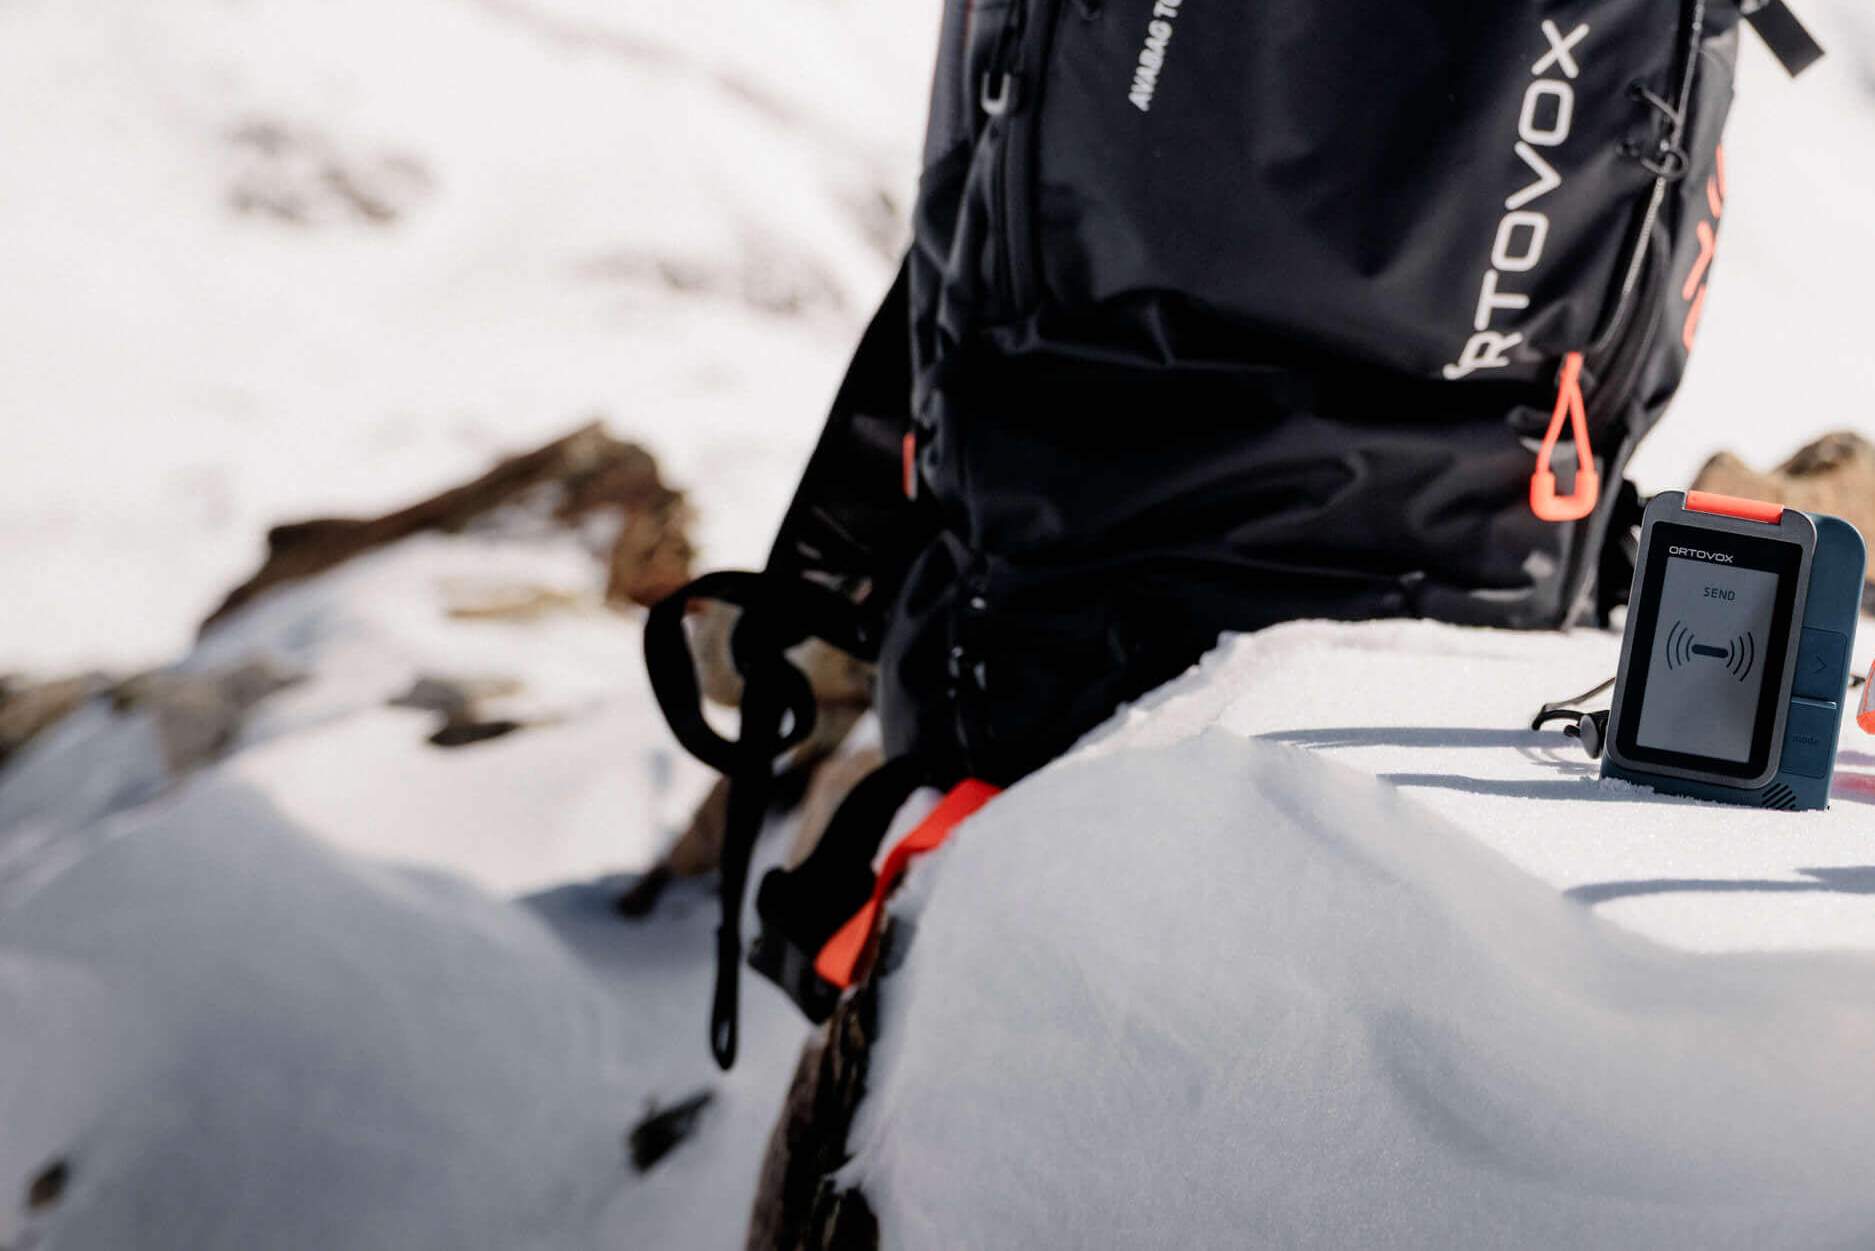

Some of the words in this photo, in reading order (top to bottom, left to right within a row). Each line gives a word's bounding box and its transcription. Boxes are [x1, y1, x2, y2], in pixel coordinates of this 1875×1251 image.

[1442, 19, 1591, 381] RTOVOX
[1668, 545, 1734, 563] ORTOVOX
[1703, 587, 1736, 601] SEND
